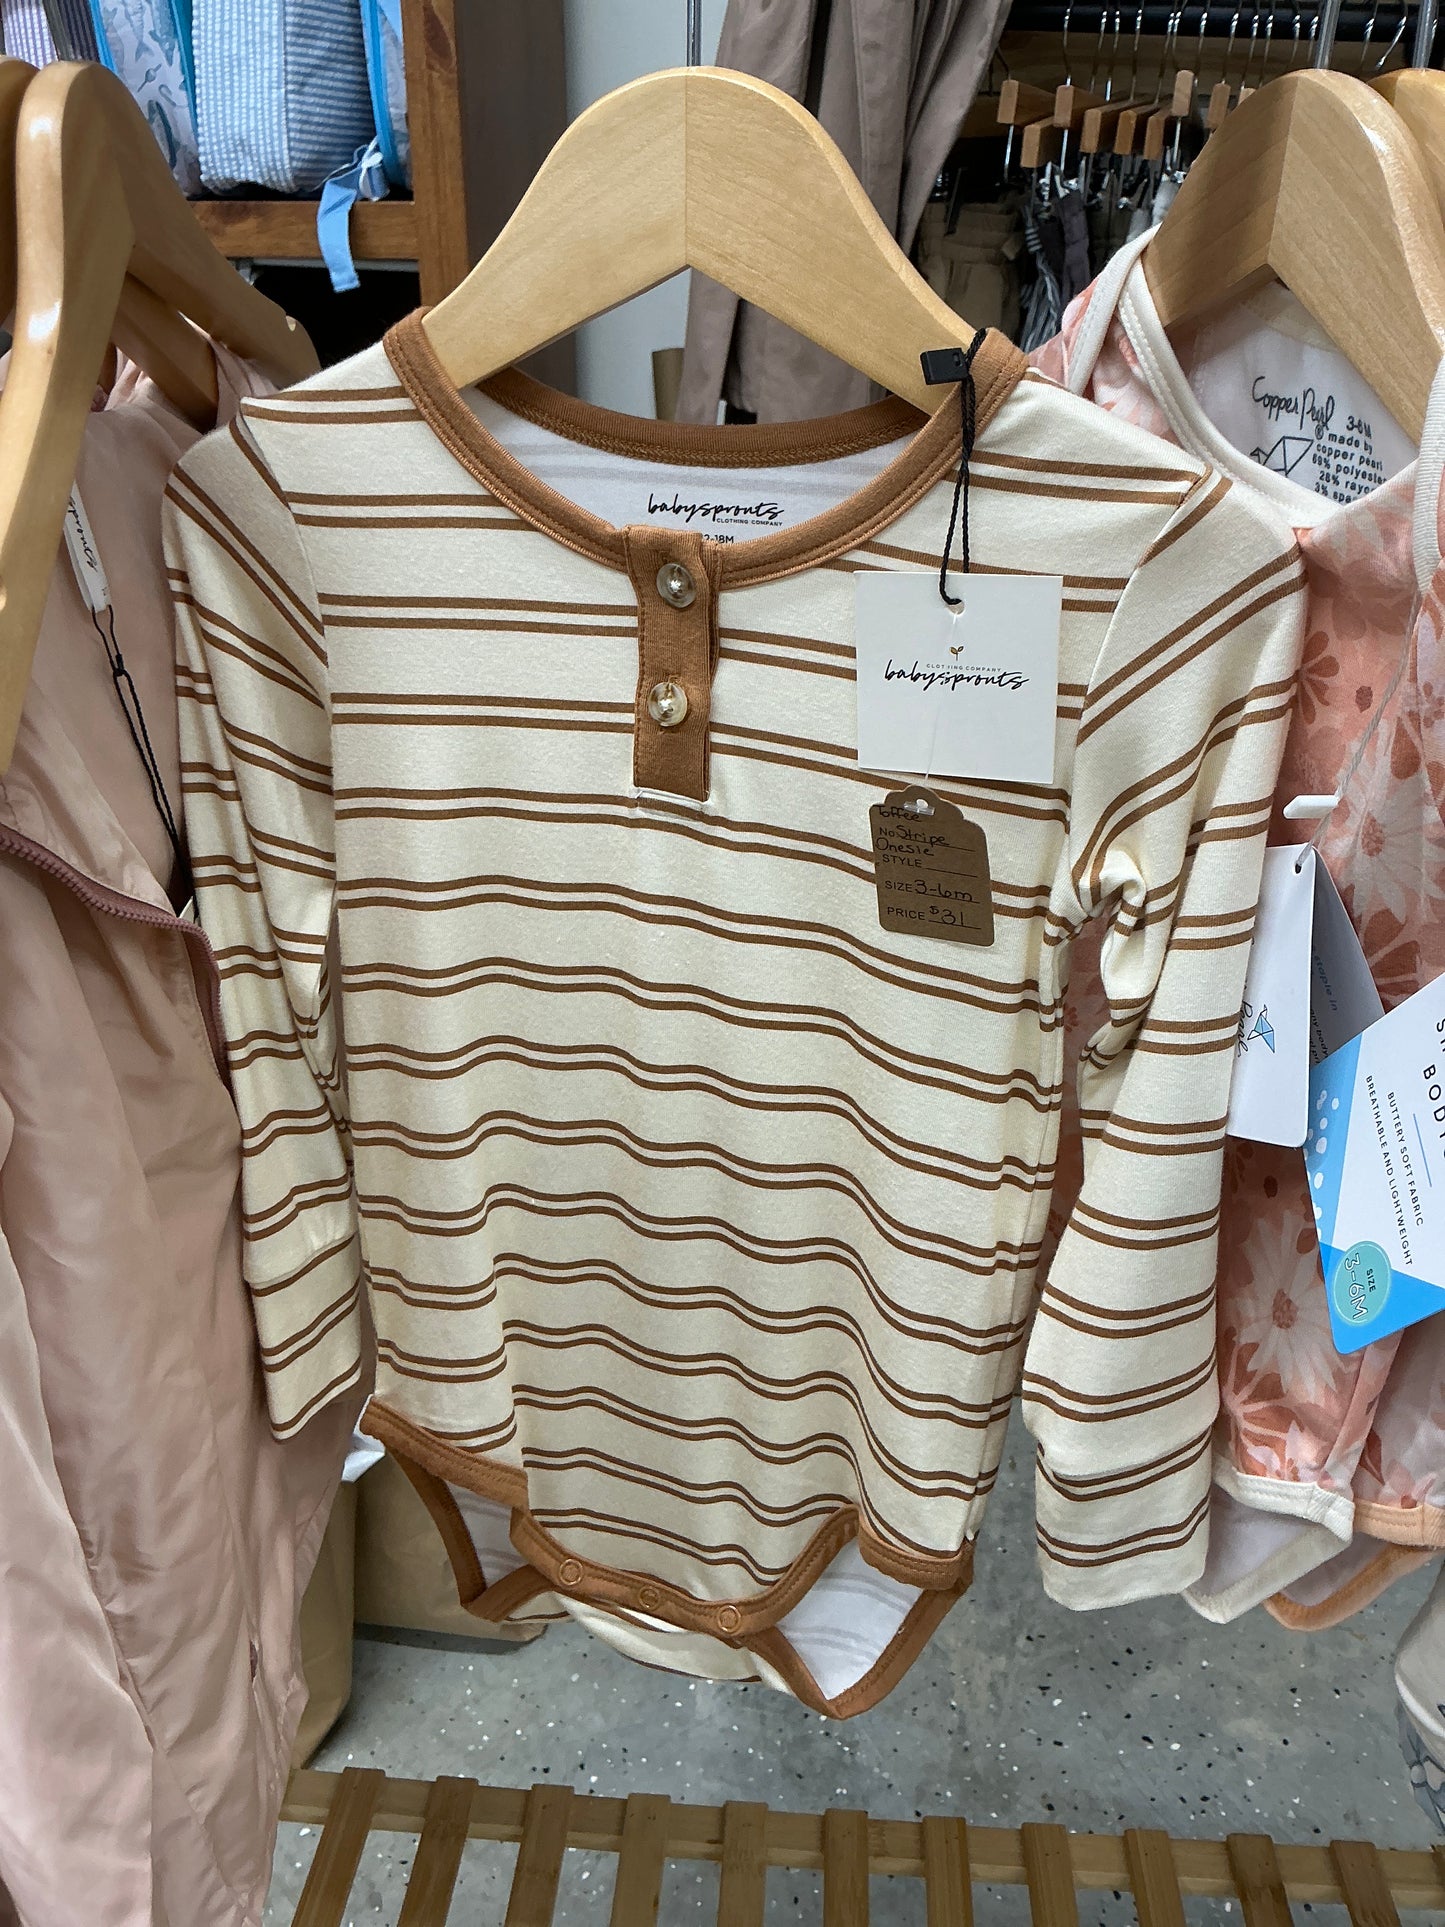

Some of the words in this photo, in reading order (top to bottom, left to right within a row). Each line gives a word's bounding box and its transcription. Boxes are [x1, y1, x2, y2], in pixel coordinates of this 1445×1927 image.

[1252, 376, 1298, 421] Copper
[1300, 388, 1335, 430] Pearl
[1328, 433, 1360, 448] made
[1364, 440, 1373, 455] by
[1316, 443, 1355, 460] copper
[1359, 455, 1383, 471] pearl
[1314, 482, 1328, 496] 3%
[1345, 480, 1374, 495] rayo
[648, 493, 784, 523] babysprouts
[751, 519, 783, 527] COMPANY
[885, 659, 1029, 691] babysprouts
[965, 665, 1002, 673] COMPANY
[875, 837, 935, 856] Onesie
[896, 825, 947, 848] Stripe
[882, 854, 923, 869] STYLE
[885, 880, 912, 893] SIZE
[887, 907, 926, 921] PRICE
[1387, 1091, 1406, 1143] BUTTERY
[1400, 1146, 1413, 1177] SOFT
[1407, 1180, 1424, 1226] FABRIC
[1366, 1075, 1388, 1149] BREATHABLE
[1382, 1151, 1394, 1176] AND
[1389, 1178, 1413, 1265] LIGHTWEIGHT
[1345, 1252, 1369, 1320] 3-6M
[1367, 1268, 1377, 1292] SIZE
